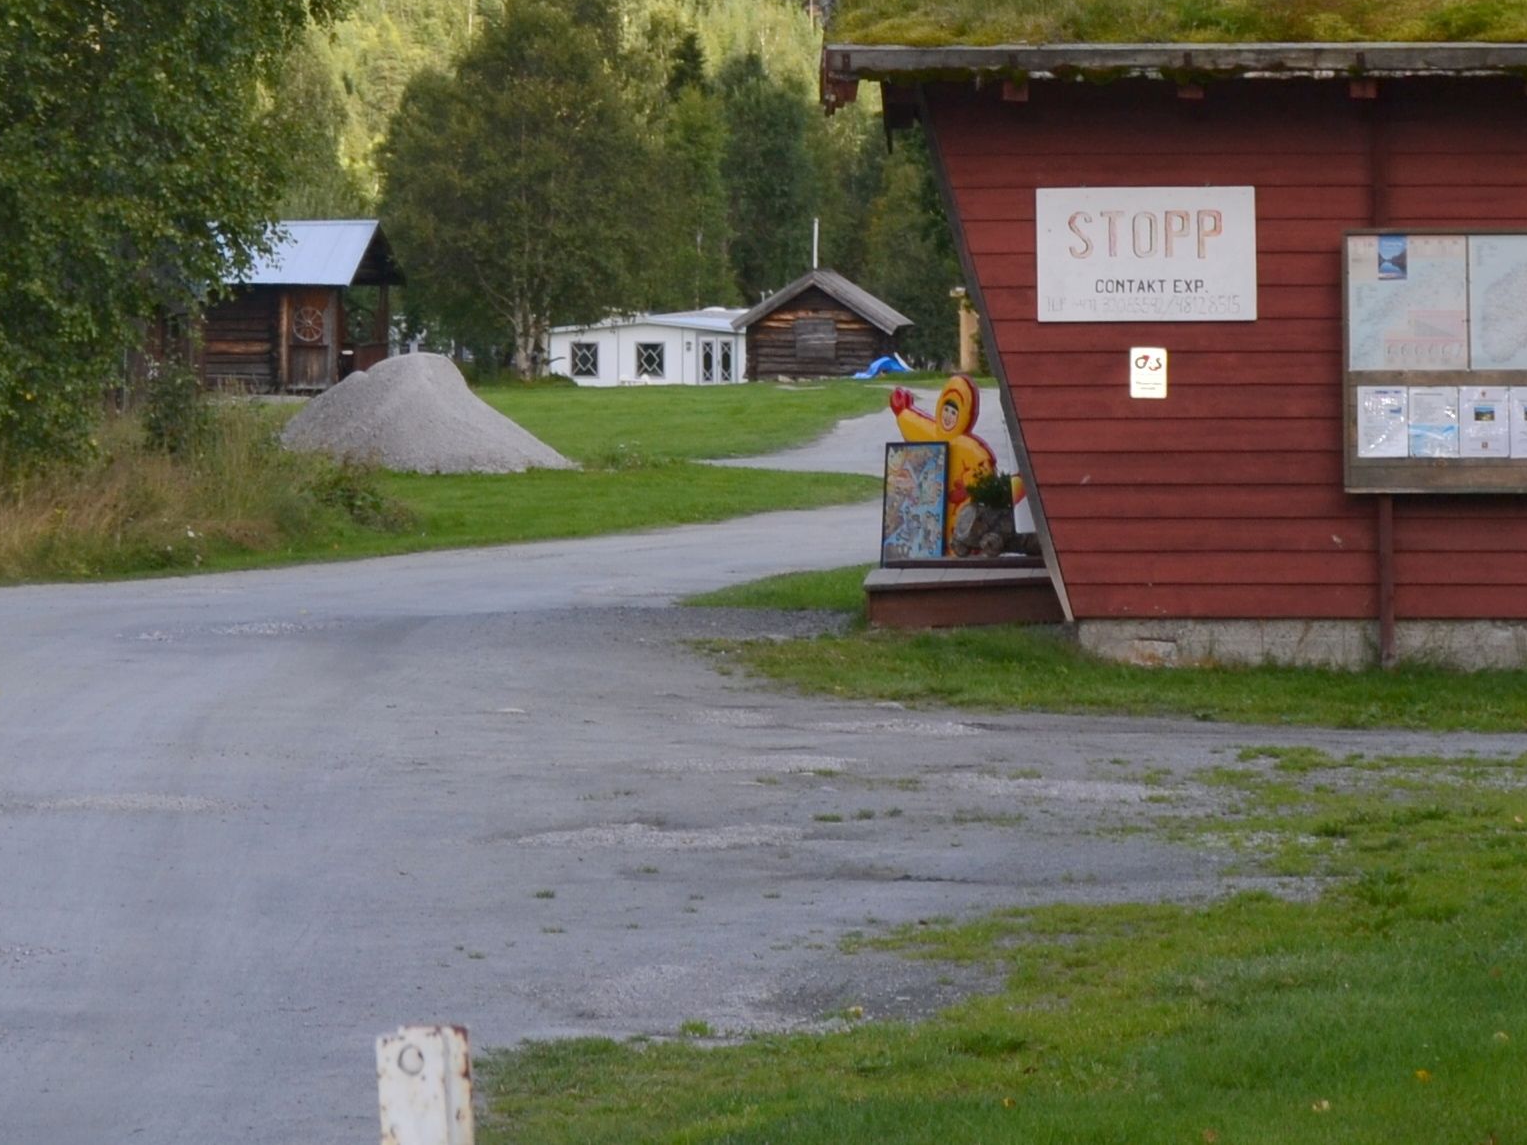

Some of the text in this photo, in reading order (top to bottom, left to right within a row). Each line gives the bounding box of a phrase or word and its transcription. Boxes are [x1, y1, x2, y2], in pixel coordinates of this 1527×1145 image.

[1067, 209, 1222, 259] STOPP
[1095, 279, 1209, 294] CONTAKT EXP.
